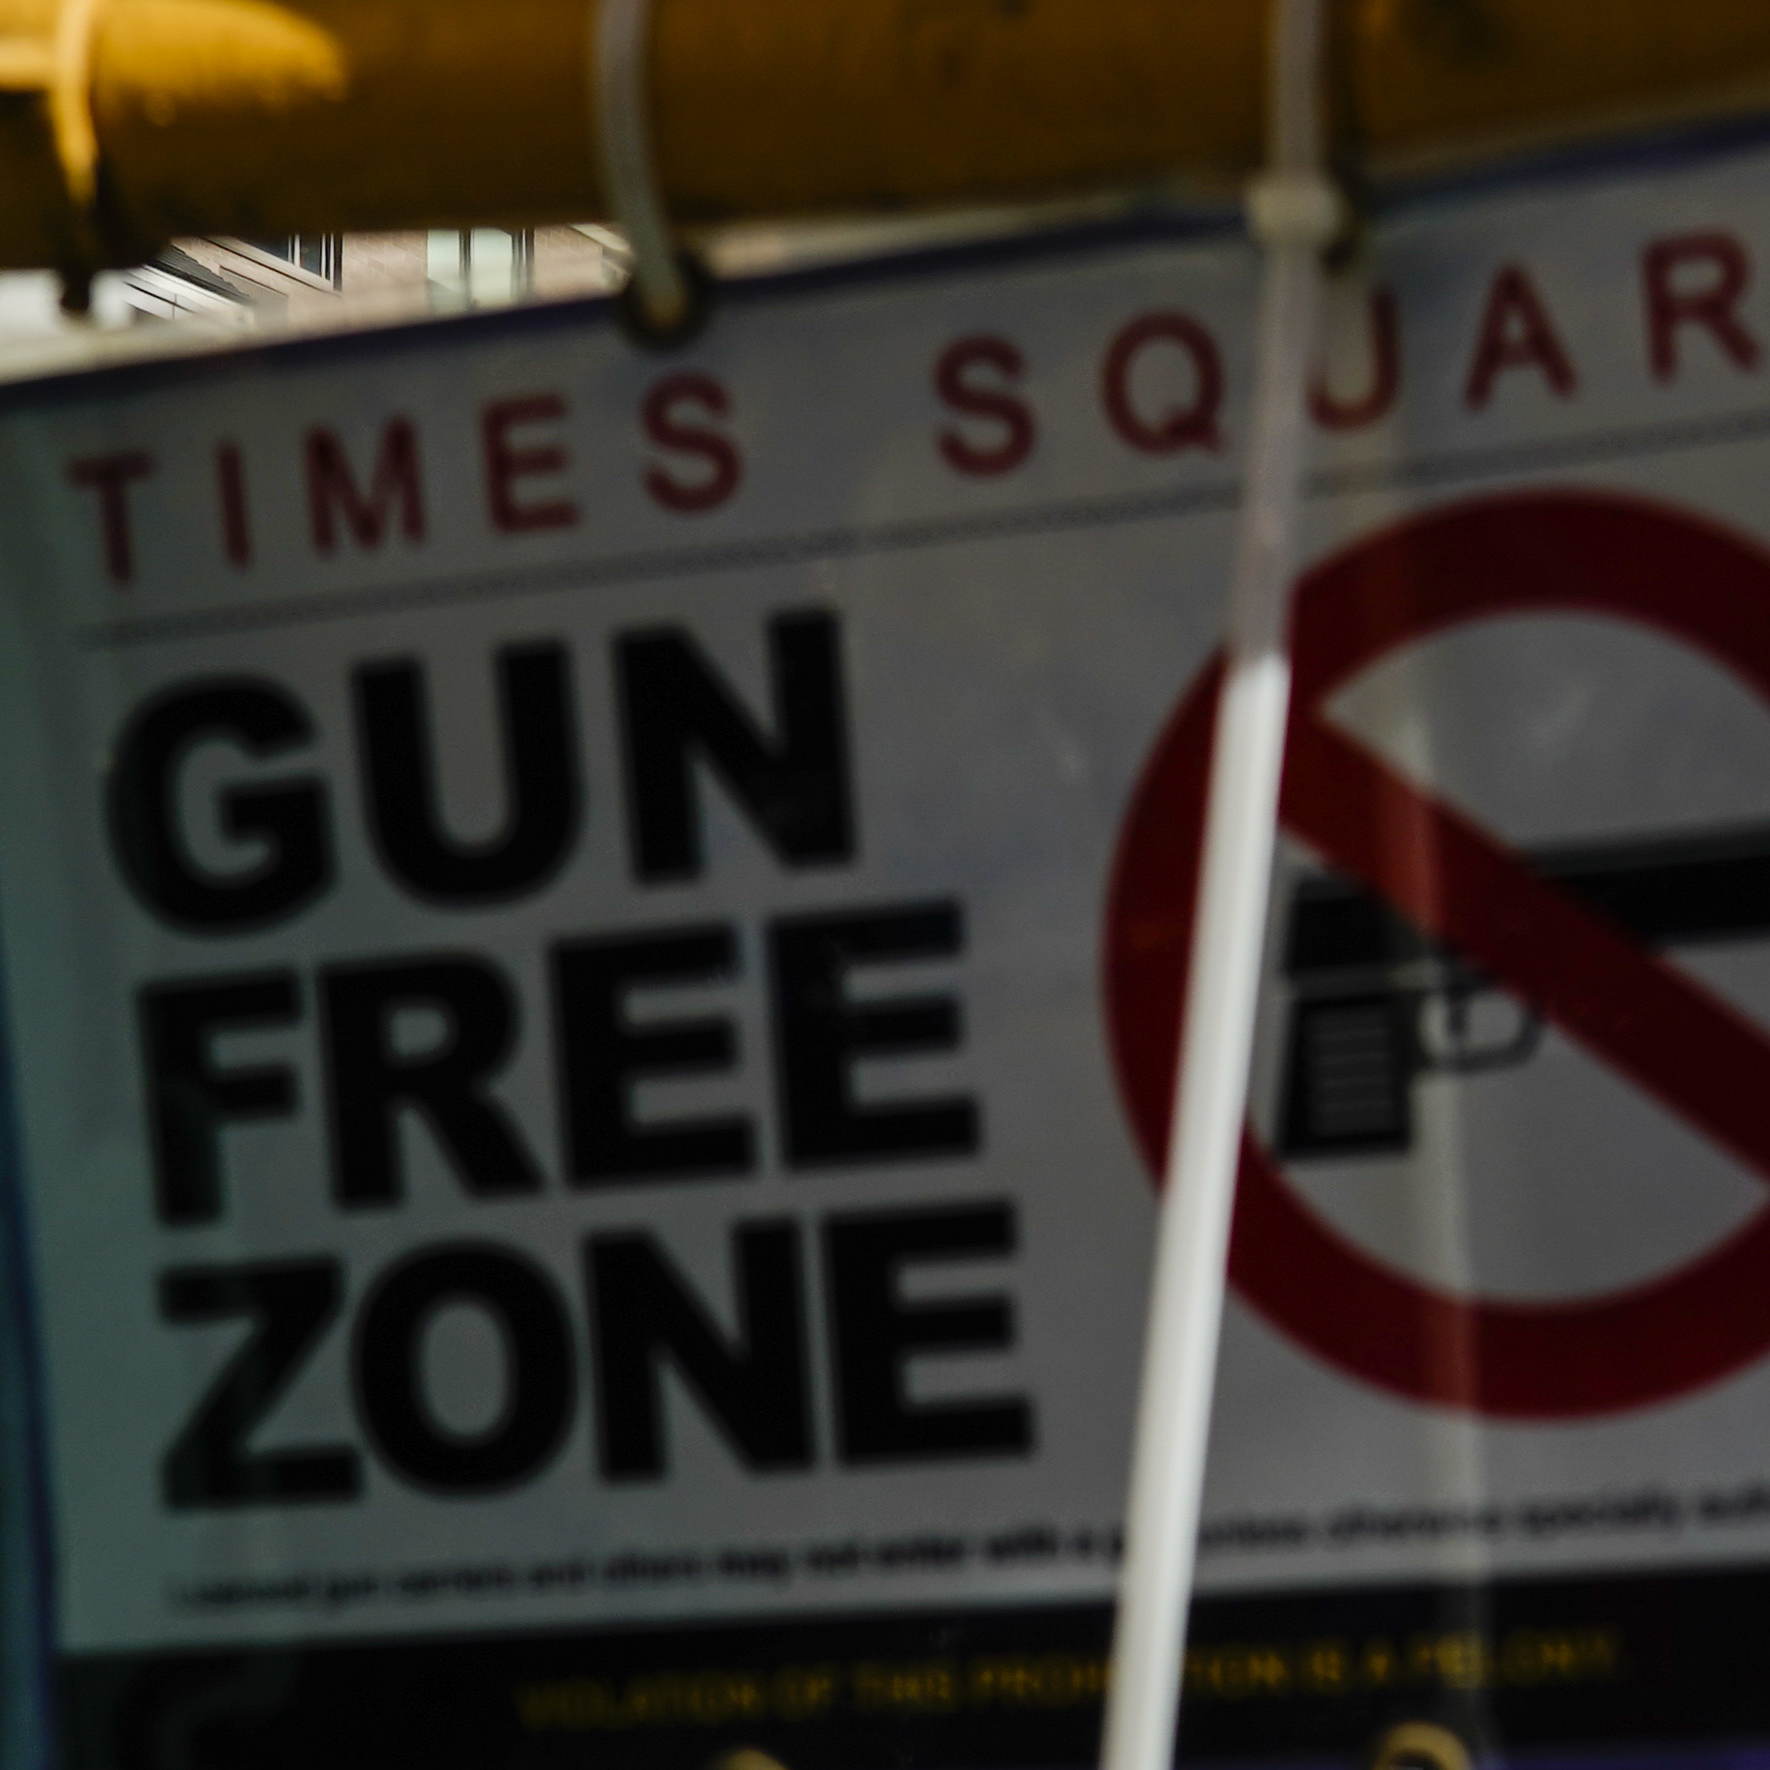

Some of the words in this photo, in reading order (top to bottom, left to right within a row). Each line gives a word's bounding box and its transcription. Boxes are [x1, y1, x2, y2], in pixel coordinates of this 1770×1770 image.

[64, 370, 742, 588] TIMES
[106, 608, 860, 936] GUN
[134, 898, 982, 1228] FREE
[157, 1198, 1038, 1513] ZONE
